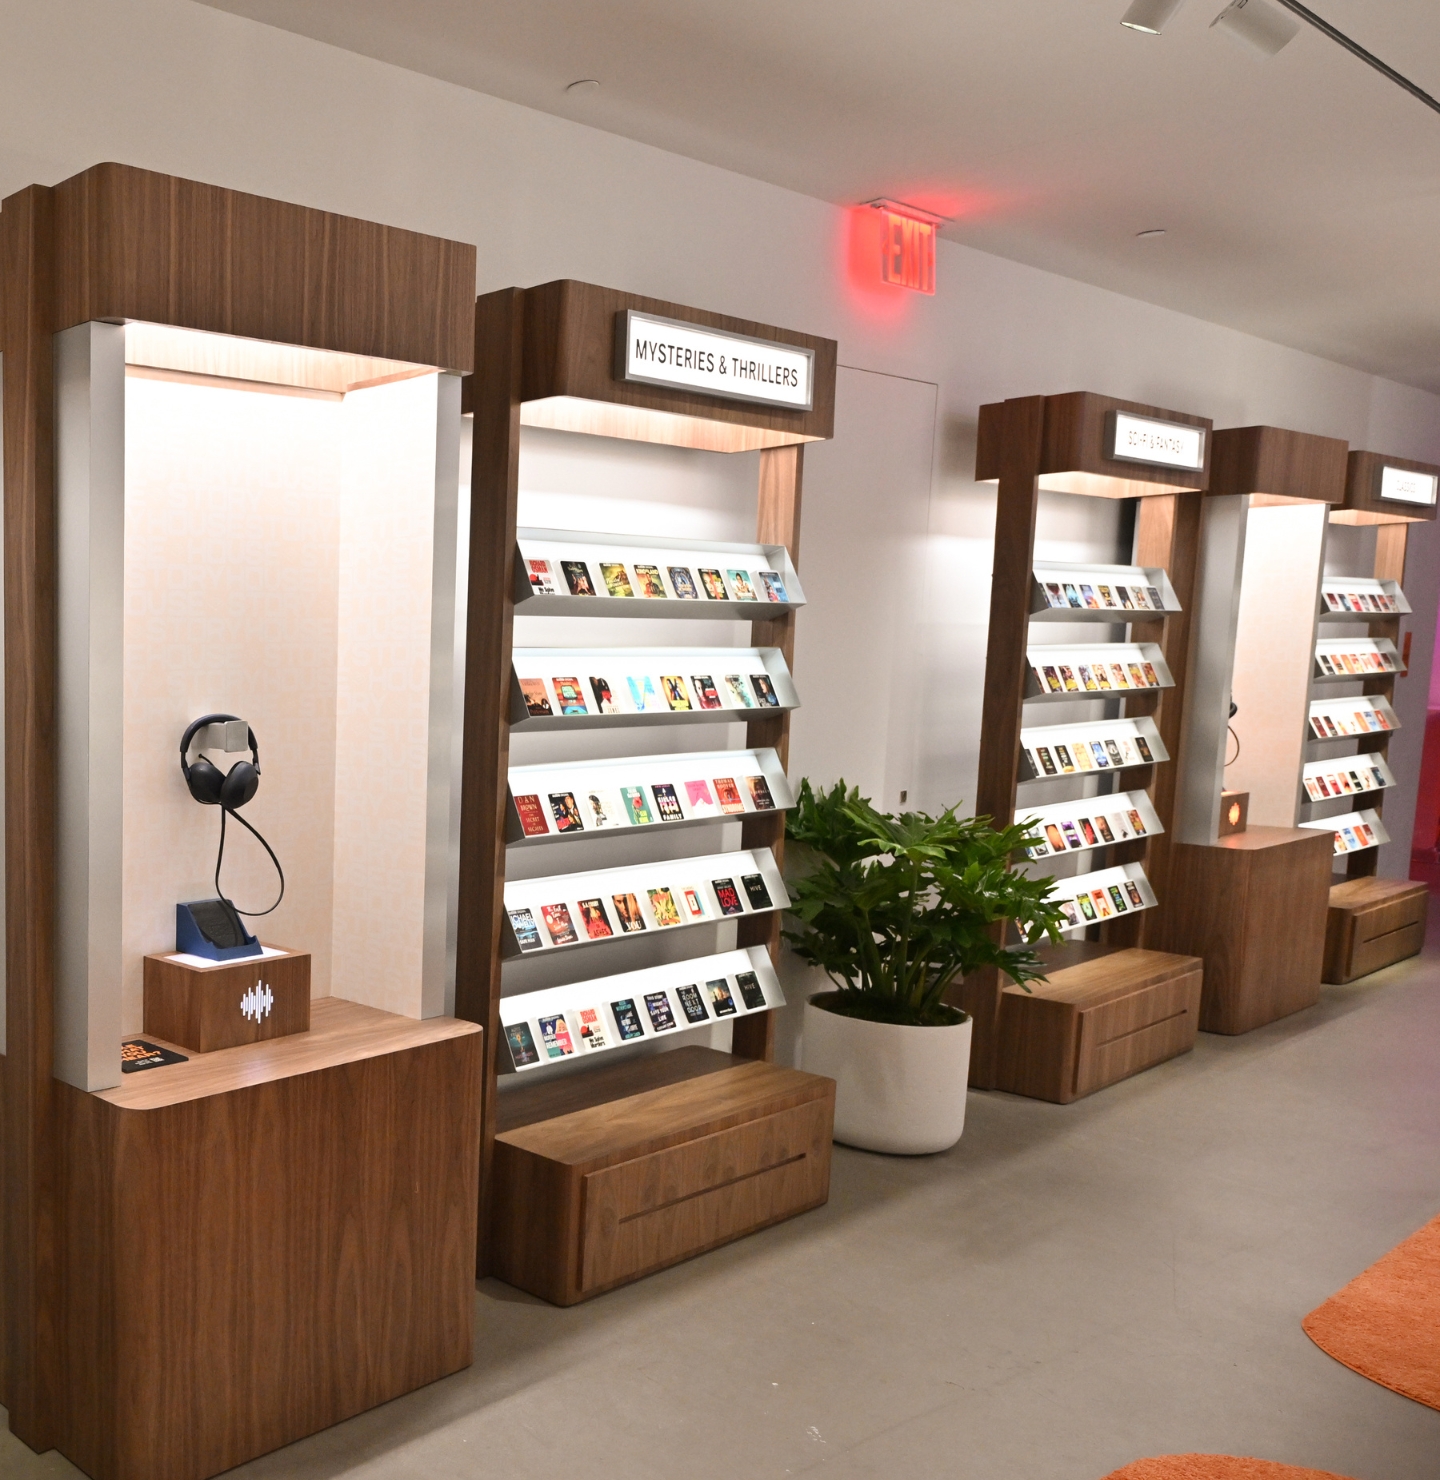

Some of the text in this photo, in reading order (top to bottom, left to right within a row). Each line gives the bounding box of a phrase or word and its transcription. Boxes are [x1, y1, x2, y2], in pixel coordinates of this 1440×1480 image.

[888, 213, 932, 291] EXIT
[635, 338, 799, 388] MYSTERIES & THRILLERS
[717, 887, 735, 899] MAD
[720, 895, 739, 908] LOVE
